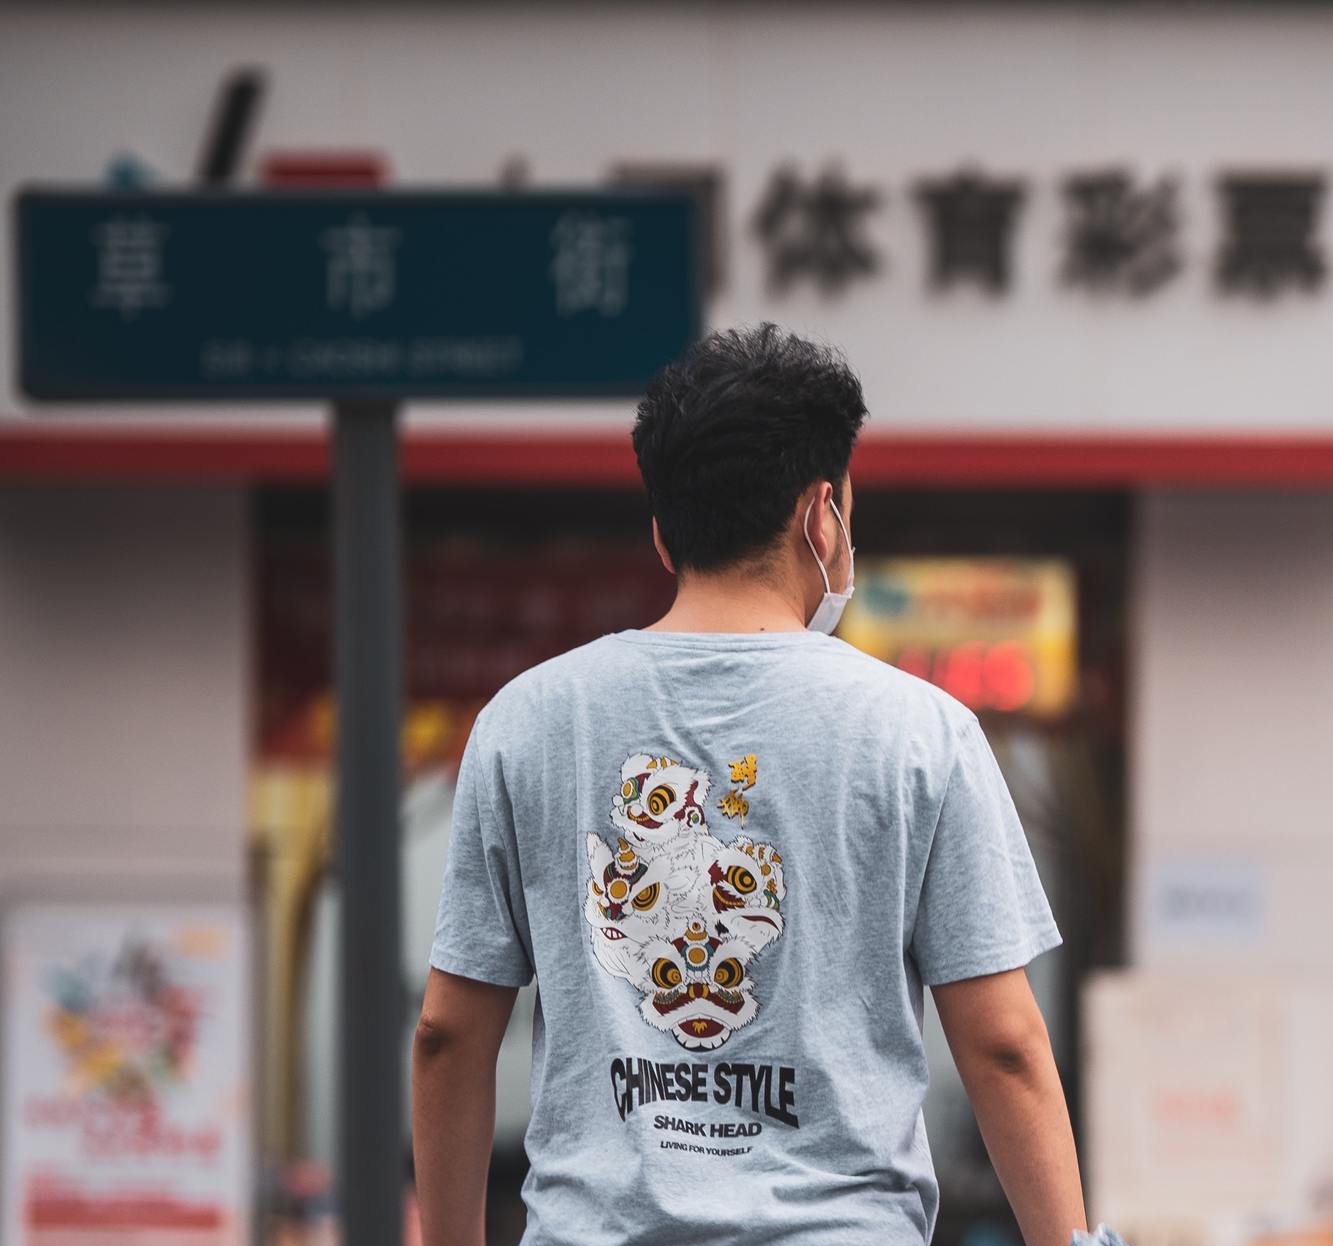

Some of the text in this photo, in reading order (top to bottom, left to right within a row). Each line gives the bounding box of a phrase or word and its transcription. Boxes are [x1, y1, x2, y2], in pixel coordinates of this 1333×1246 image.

[612, 158, 1333, 302] 体育彩票
[611, 1057, 800, 1129] CHINESE STYLE
[654, 1114, 762, 1138] SHARK HEAD
[660, 1141, 753, 1157] LIVING FOR YOURSELF
